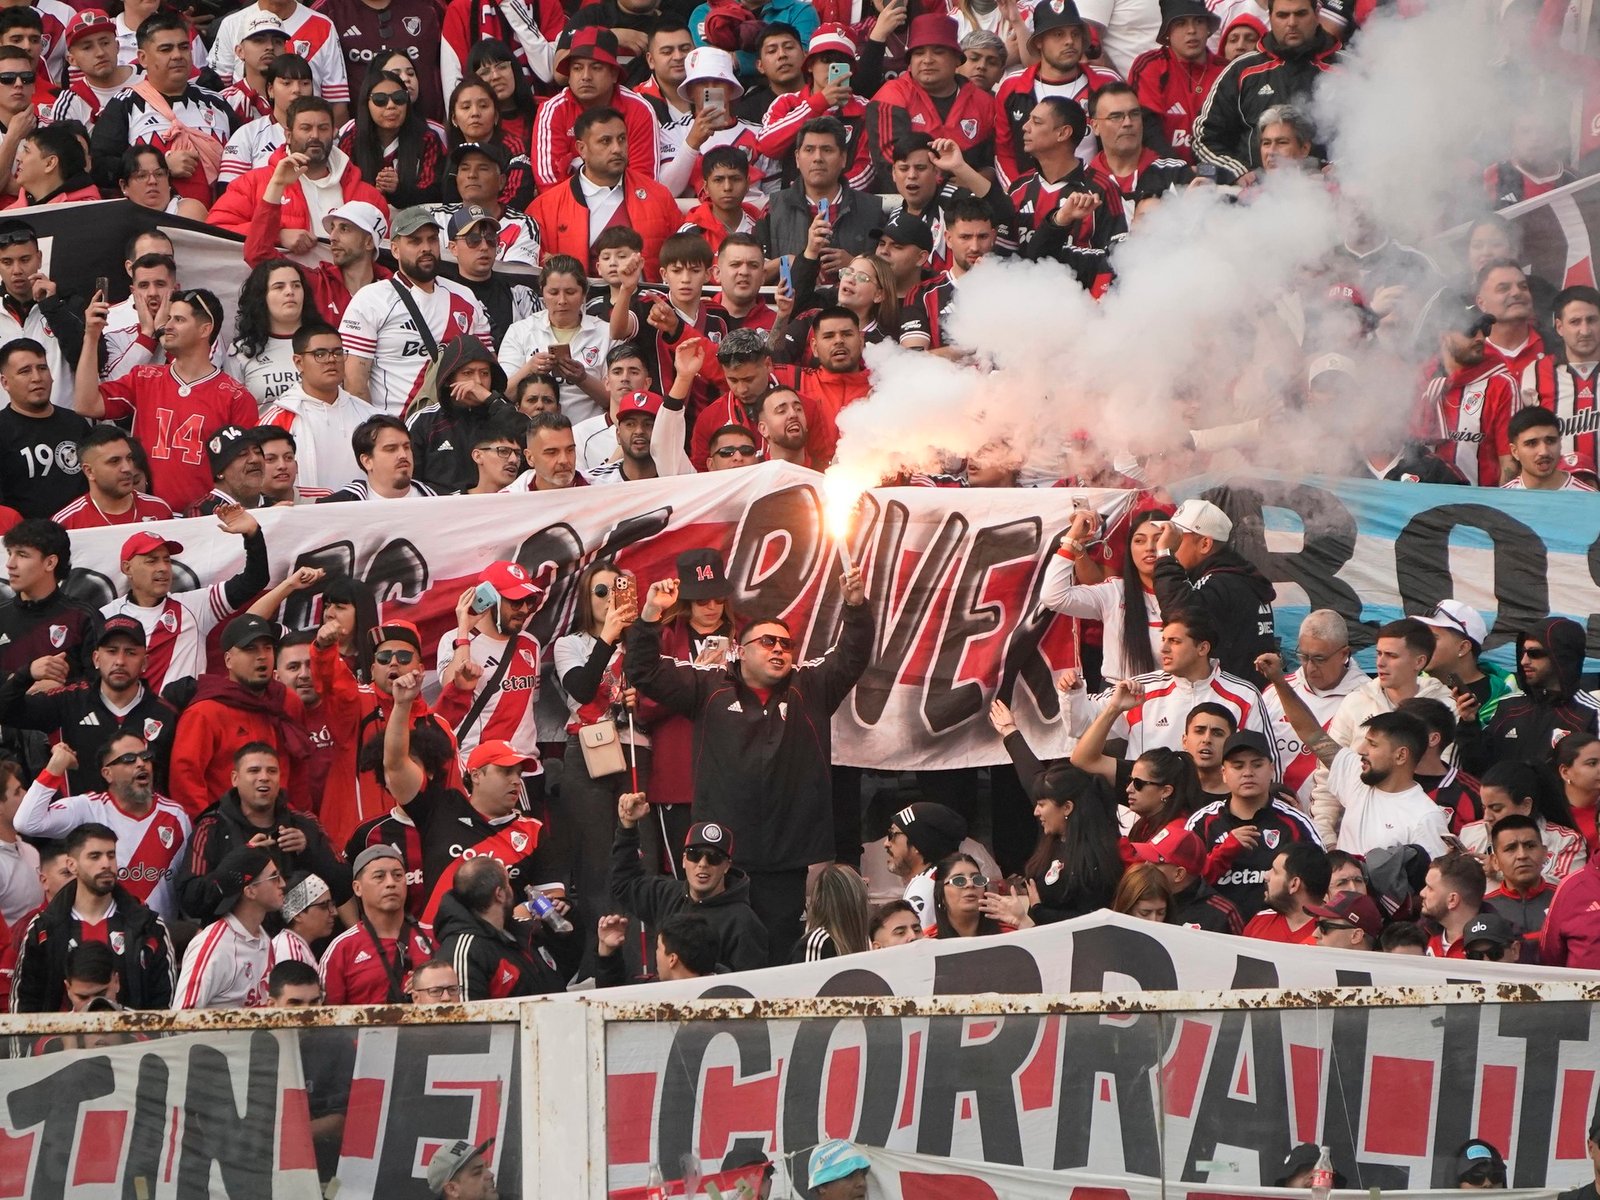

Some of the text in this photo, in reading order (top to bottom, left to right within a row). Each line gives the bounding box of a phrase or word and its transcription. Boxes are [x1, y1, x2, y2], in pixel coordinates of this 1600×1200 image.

[263, 371, 303, 385] TURK
[152, 407, 205, 465] 14
[696, 564, 714, 581] 14
[116, 862, 172, 882] odere
[1471, 921, 1487, 933] alo
[656, 924, 1596, 1190] CORRALIT
